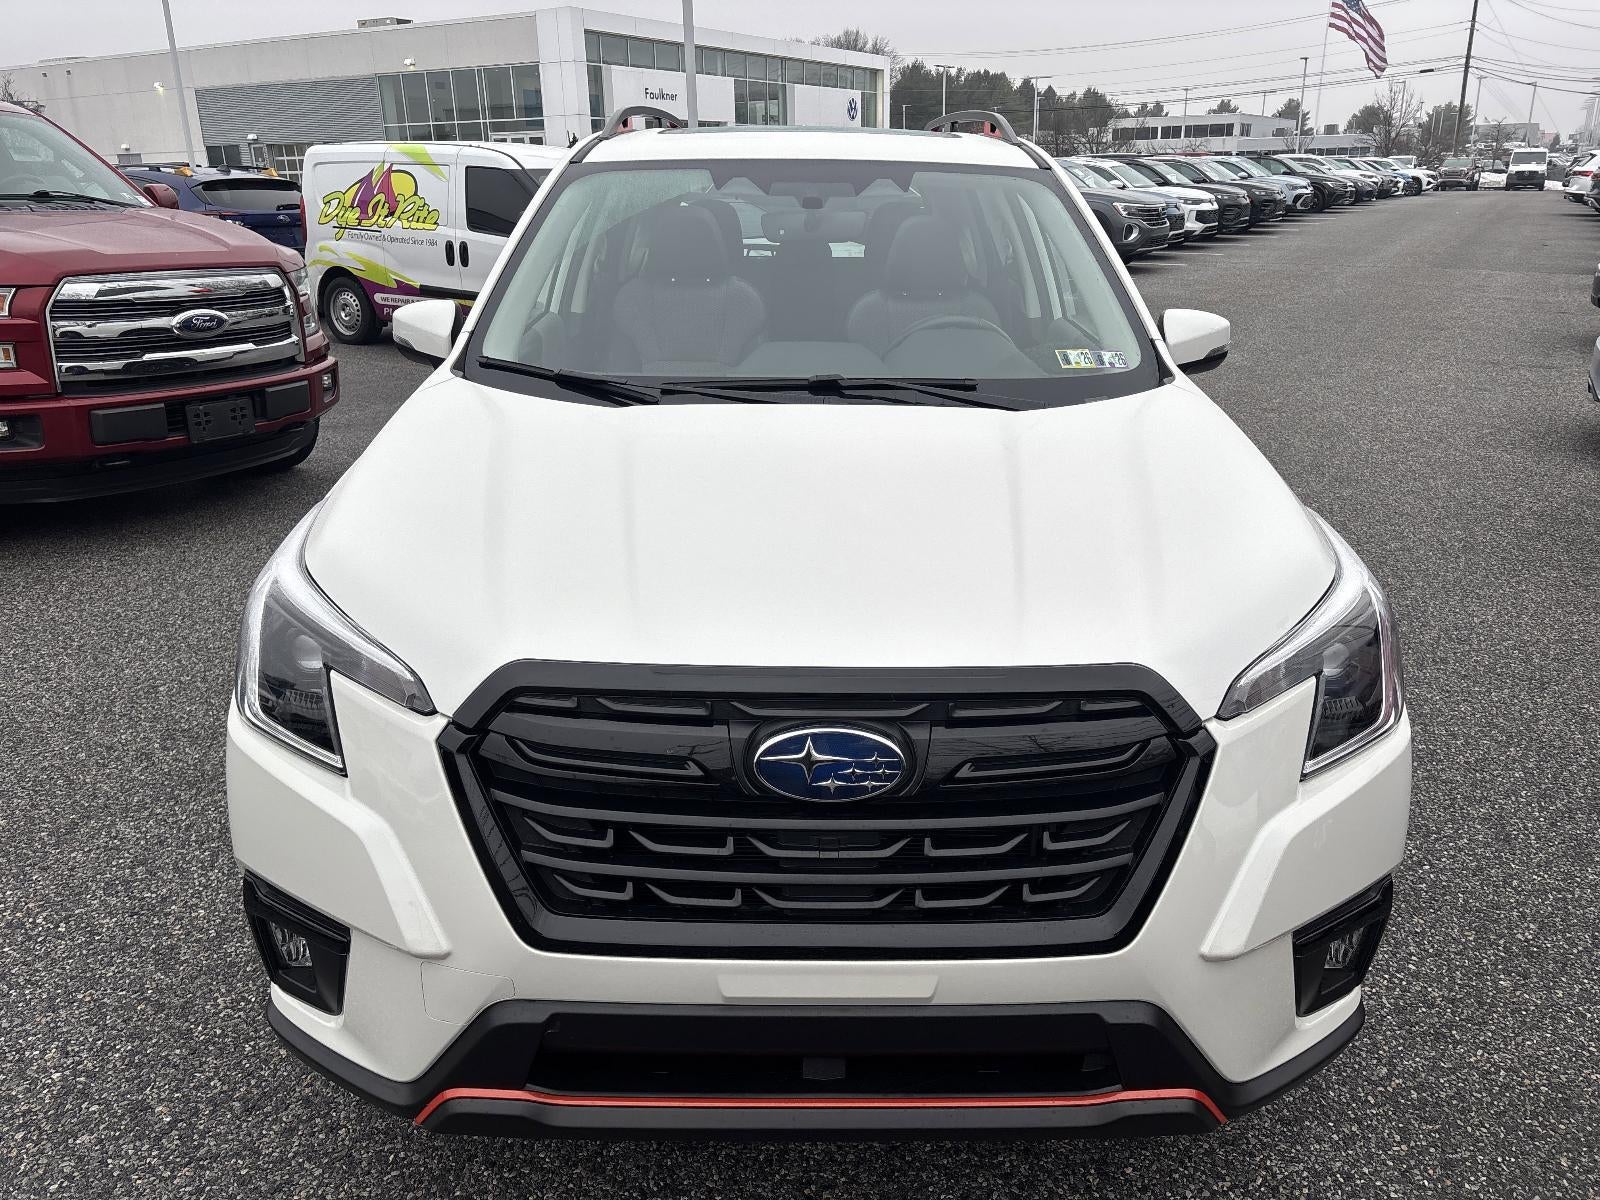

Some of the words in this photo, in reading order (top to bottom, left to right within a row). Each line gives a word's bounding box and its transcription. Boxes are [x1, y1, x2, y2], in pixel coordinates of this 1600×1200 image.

[644, 87, 678, 102] Faulkner
[318, 190, 361, 241] Dye
[360, 192, 390, 228] It
[386, 193, 440, 231] Rite
[347, 230, 363, 241] Family
[364, 232, 382, 242] Owned
[386, 235, 411, 245] Operated
[411, 237, 424, 245] Since
[425, 239, 438, 247] 1984
[192, 316, 218, 330] Ford
